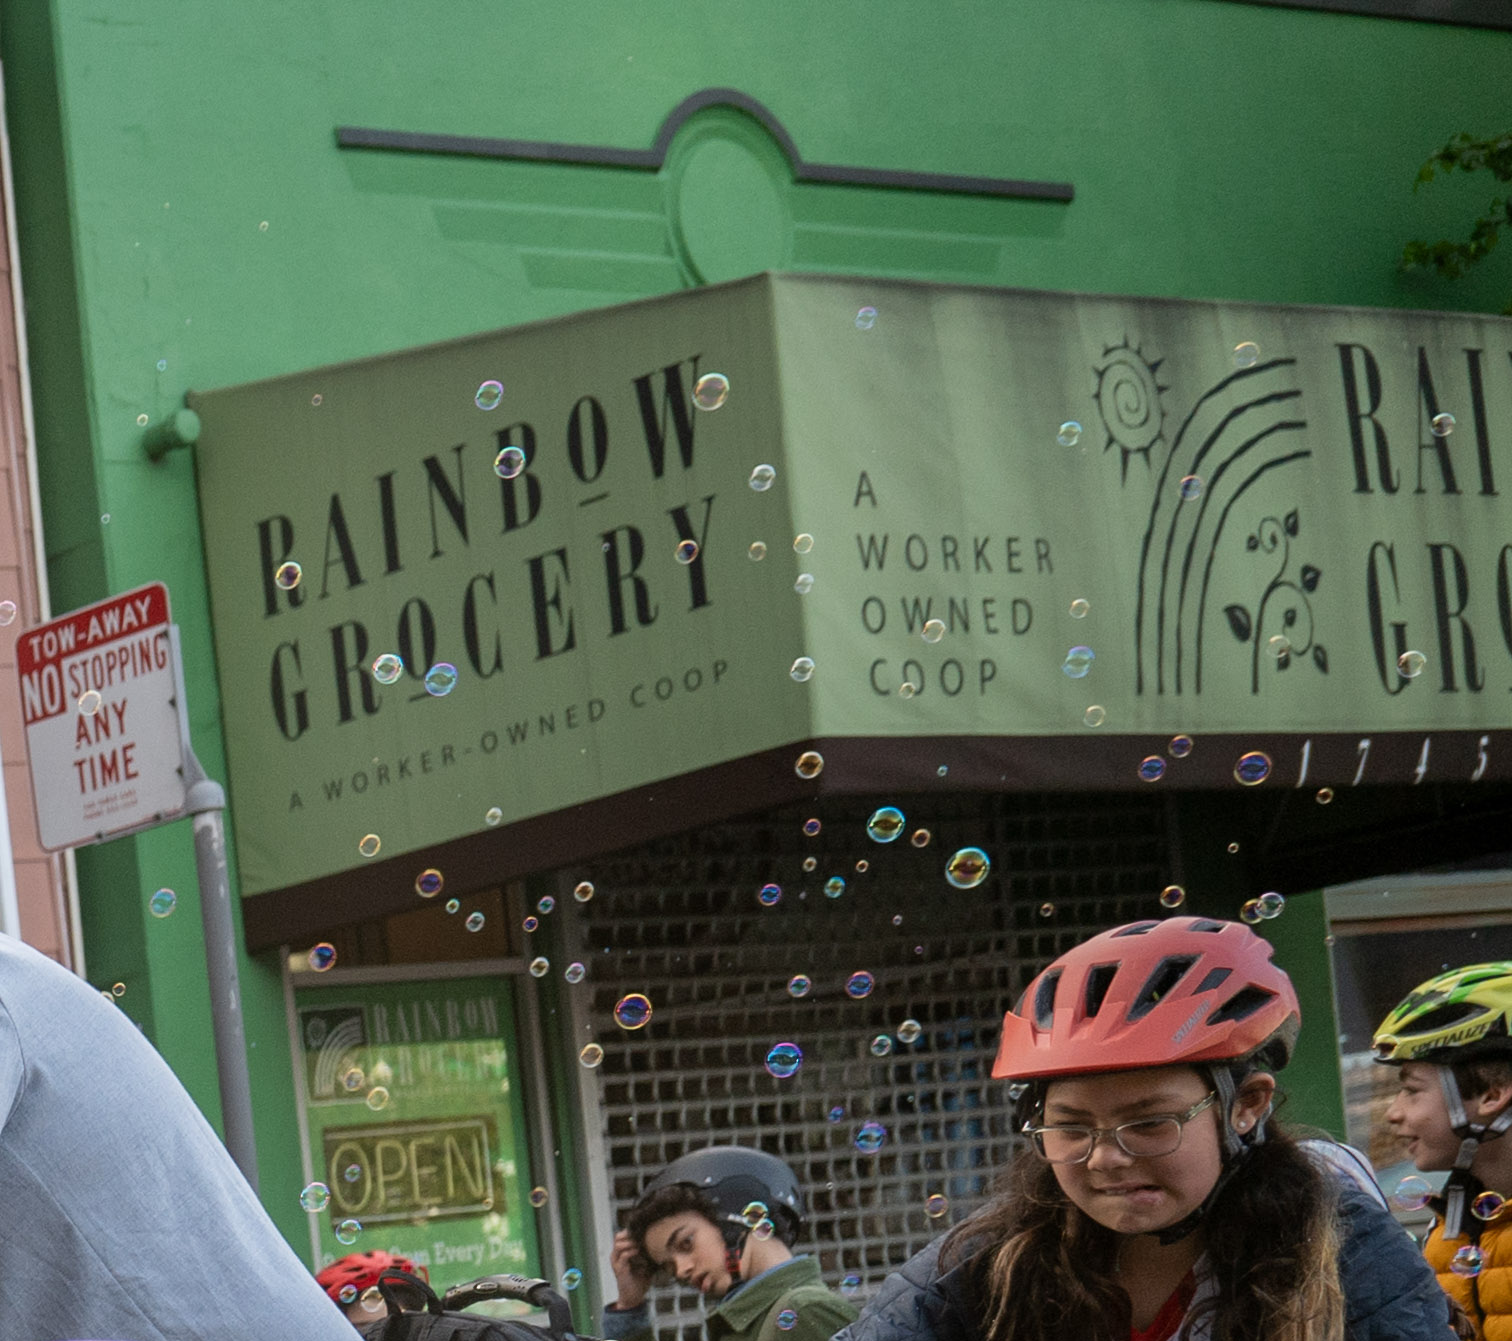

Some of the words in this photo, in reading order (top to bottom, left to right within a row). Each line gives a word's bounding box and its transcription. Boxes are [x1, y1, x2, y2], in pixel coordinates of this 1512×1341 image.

[1335, 342, 1512, 497] RAI
[255, 354, 703, 620] RAINBOW
[854, 470, 878, 508] A
[856, 533, 1055, 576] WORKER
[28, 595, 153, 664] TOW-AWAY
[270, 494, 717, 743] GROCERY
[861, 596, 1035, 637] OWNED
[21, 662, 64, 723] NO
[68, 632, 168, 699] STOPPING
[868, 658, 999, 698] COOP
[75, 697, 128, 749] ANY
[289, 790, 305, 813] A
[322, 698, 607, 803] WORKER-OWNED
[629, 658, 730, 710] COOP
[74, 742, 140, 794] TIME
[330, 1134, 485, 1213] OPEN
[432, 1239, 485, 1266] Every
